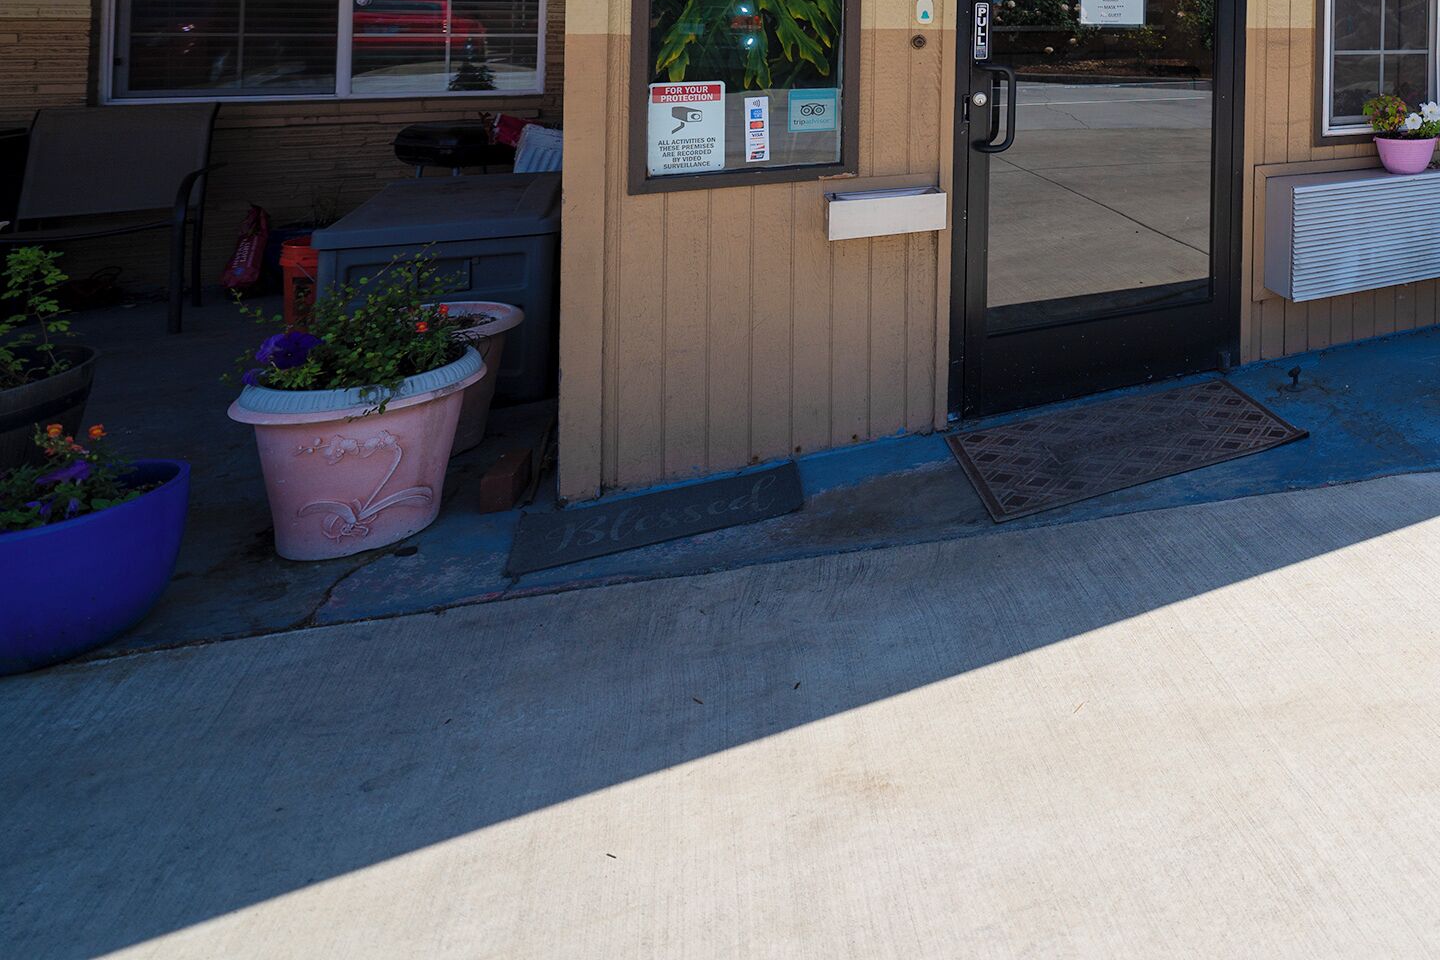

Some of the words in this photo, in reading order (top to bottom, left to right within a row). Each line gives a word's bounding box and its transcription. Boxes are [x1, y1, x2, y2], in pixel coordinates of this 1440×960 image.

[977, 7, 987, 46] PULL
[665, 87, 682, 95] FOR
[685, 86, 708, 94] YOUR
[660, 93, 713, 102] PROTECTION
[671, 137, 705, 145] ACTIVITIES
[677, 149, 712, 157] RECORDED
[663, 161, 711, 170] SURVEILLANCE
[545, 474, 777, 553] Blessed
